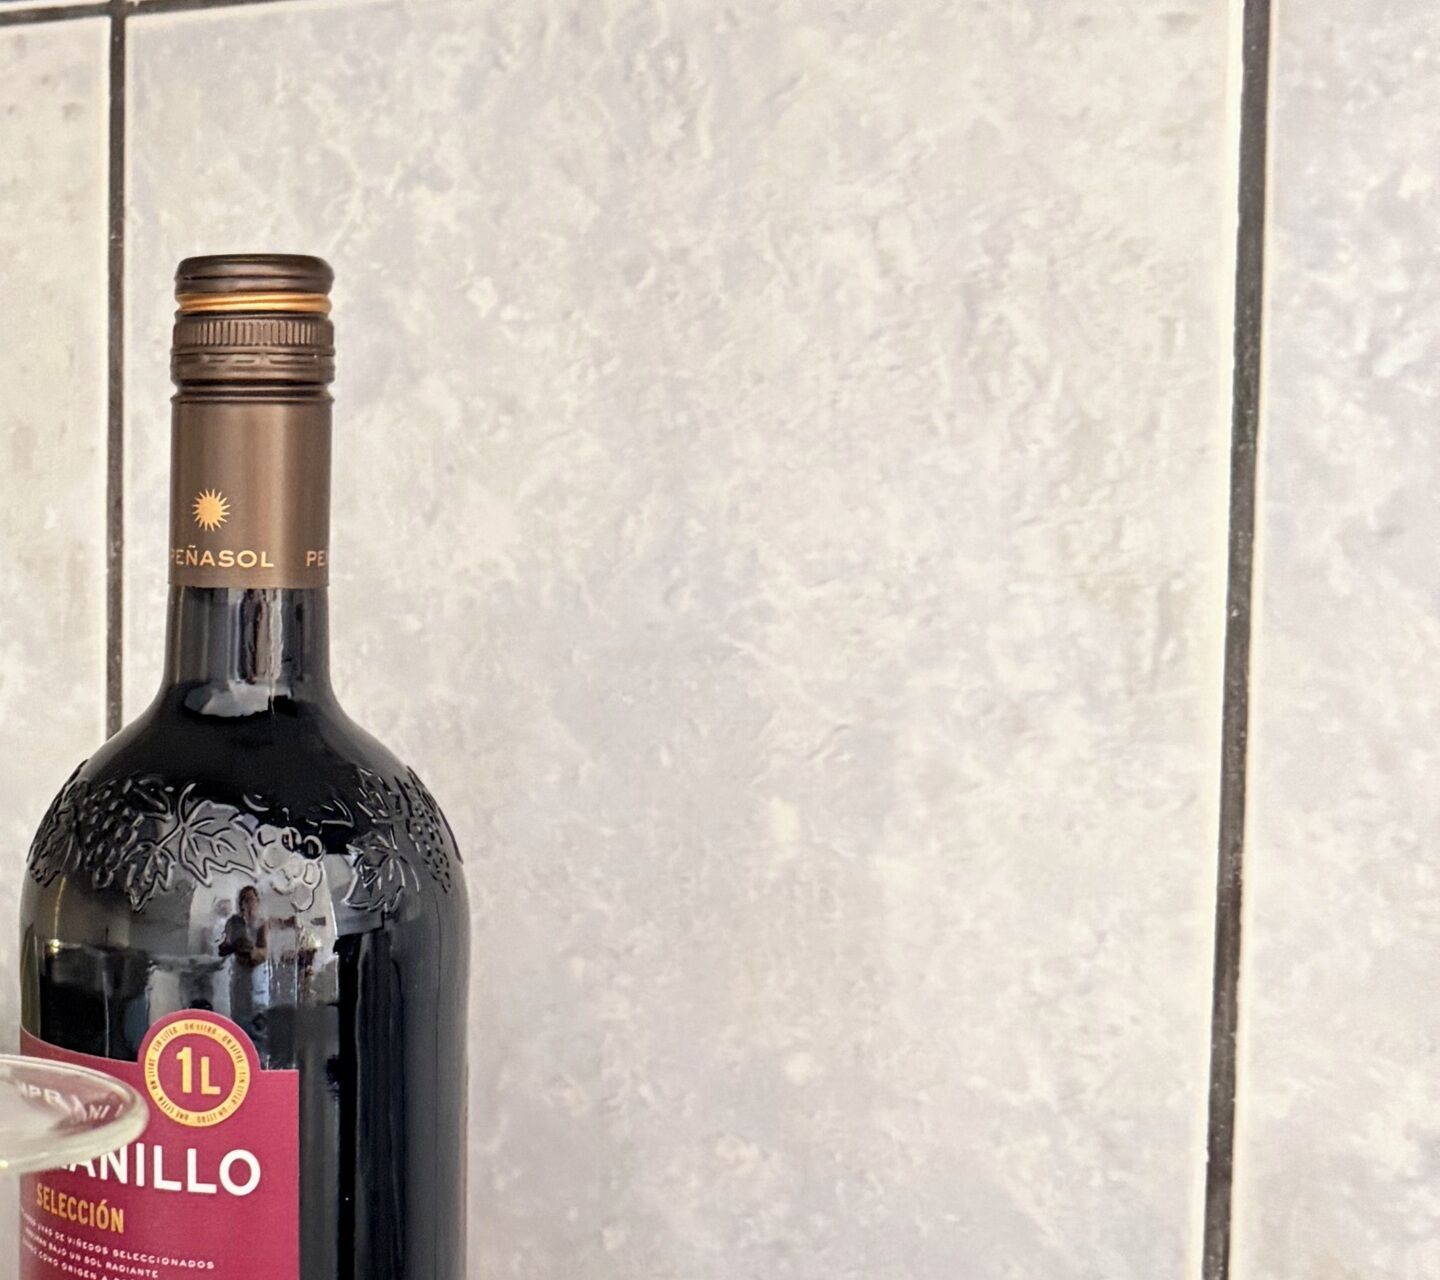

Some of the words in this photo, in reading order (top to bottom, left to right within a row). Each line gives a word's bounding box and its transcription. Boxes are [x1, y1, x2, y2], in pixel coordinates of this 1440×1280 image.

[175, 1046, 221, 1095] 1L
[36, 1183, 125, 1234] SELECCIÓN
[67, 1236, 109, 1255] VIÑEDOS
[112, 1248, 215, 1270] SELECCIONADOS
[83, 1255, 102, 1268] SOL
[105, 1261, 159, 1279] RADIANTE
[61, 1262, 97, 1280] ORIGEN
